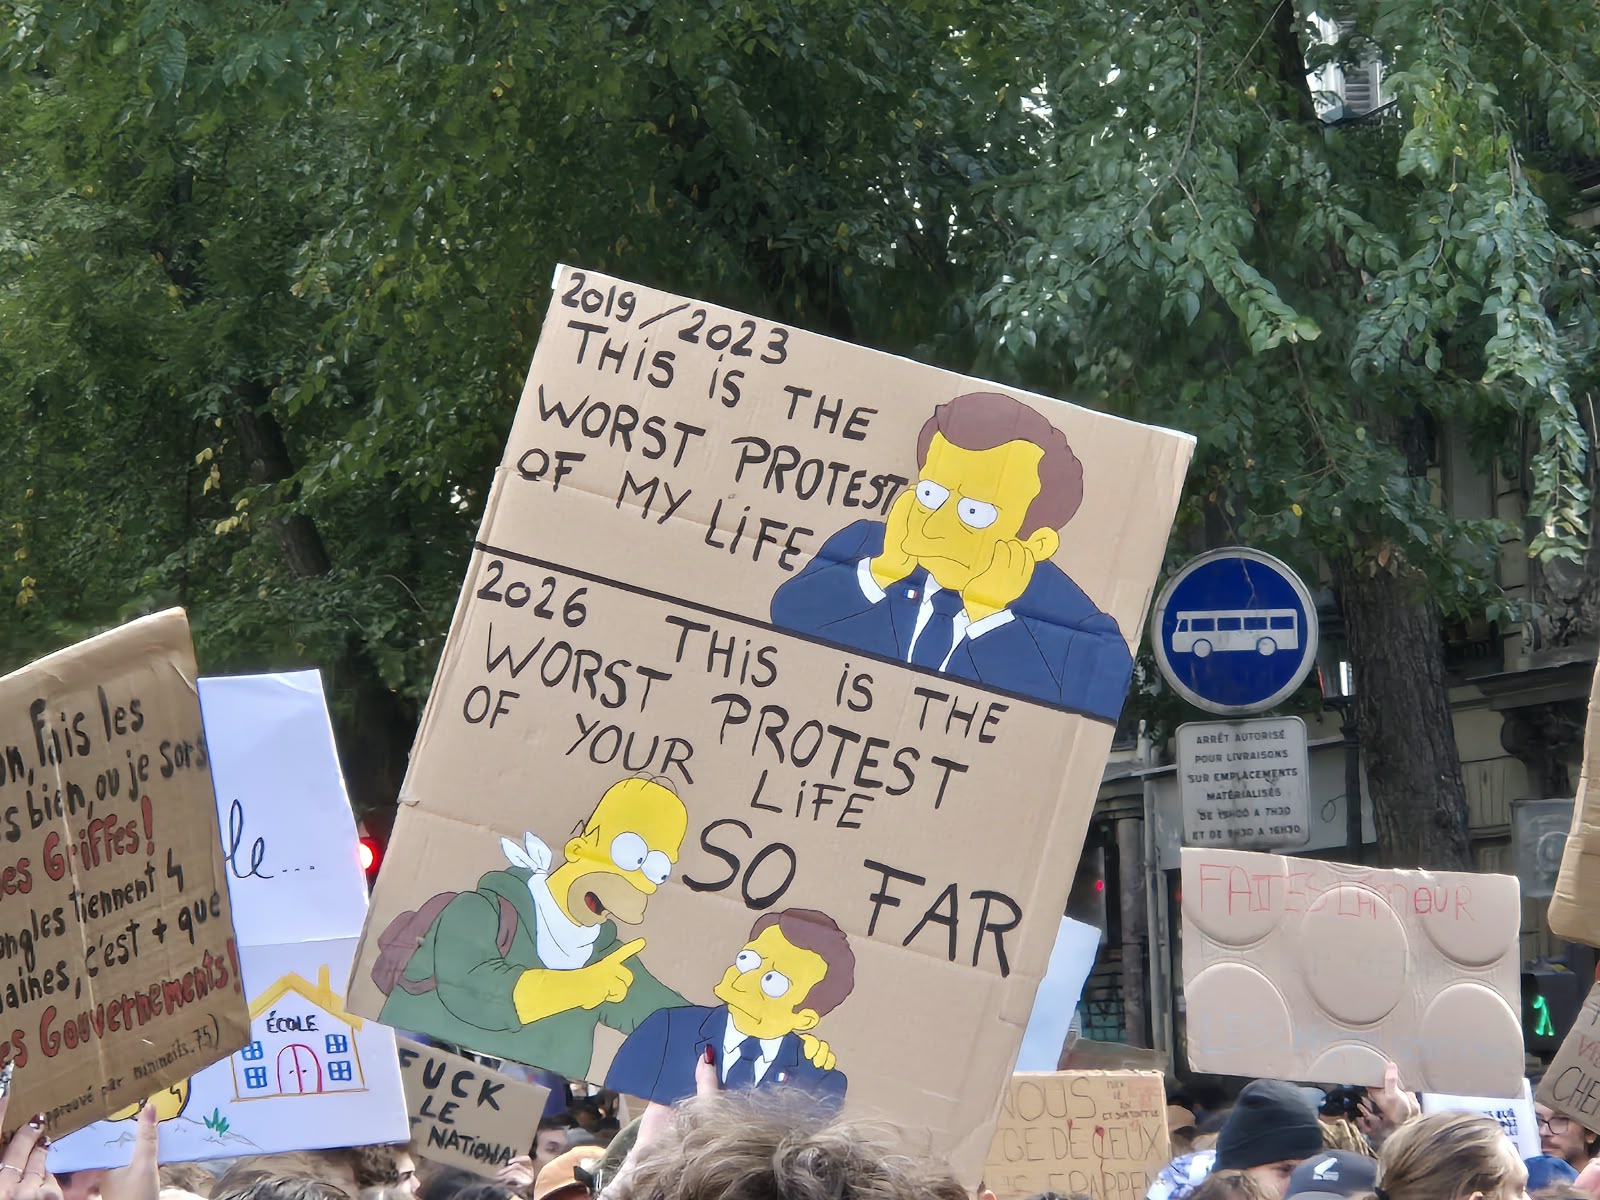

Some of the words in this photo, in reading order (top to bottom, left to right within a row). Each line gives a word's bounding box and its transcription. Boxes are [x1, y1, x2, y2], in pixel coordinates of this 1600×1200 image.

[784, 385, 879, 441] THE
[538, 383, 706, 468] WORST
[731, 436, 909, 515] PROTEST
[517, 448, 586, 492] OF
[616, 470, 692, 524] MY
[477, 560, 587, 627] 2026
[914, 687, 1009, 744] THE
[97, 685, 144, 742] les
[463, 685, 520, 729] OF
[565, 713, 694, 785] YOUR
[487, 622, 672, 713] WORST
[711, 693, 969, 810] PROTEST
[1196, 732, 1229, 744] ARRÊT
[1235, 730, 1285, 742] AUTORISÉ
[96, 767, 119, 801] ou
[126, 750, 149, 802] je
[1187, 774, 1209, 783] SUR
[1214, 768, 1298, 782] EMPLACEMENTS
[1195, 754, 1222, 764] POUR
[1227, 750, 1288, 762] LIVRAISONS
[1207, 787, 1281, 800] MATÉRIALISÉS
[1192, 831, 1204, 840] ET
[1209, 830, 1222, 839] DE
[167, 848, 184, 893] 4
[682, 818, 797, 910] SO
[864, 859, 1023, 978] FAR
[0, 960, 81, 1013] aines,
[85, 919, 140, 978] c'est
[152, 918, 167, 944] +
[178, 890, 221, 945] que
[40, 937, 243, 1057] Gouvernements!
[266, 1011, 319, 1033] ÉCOLE
[45, 1085, 94, 1130] pprouvé
[101, 1076, 124, 1105] par
[398, 1047, 505, 1111] FUCK
[1553, 1066, 1600, 1116] CHE
[419, 1095, 460, 1124] LE
[1051, 1127, 1088, 1160] DE
[1092, 1124, 1162, 1161] CEUX
